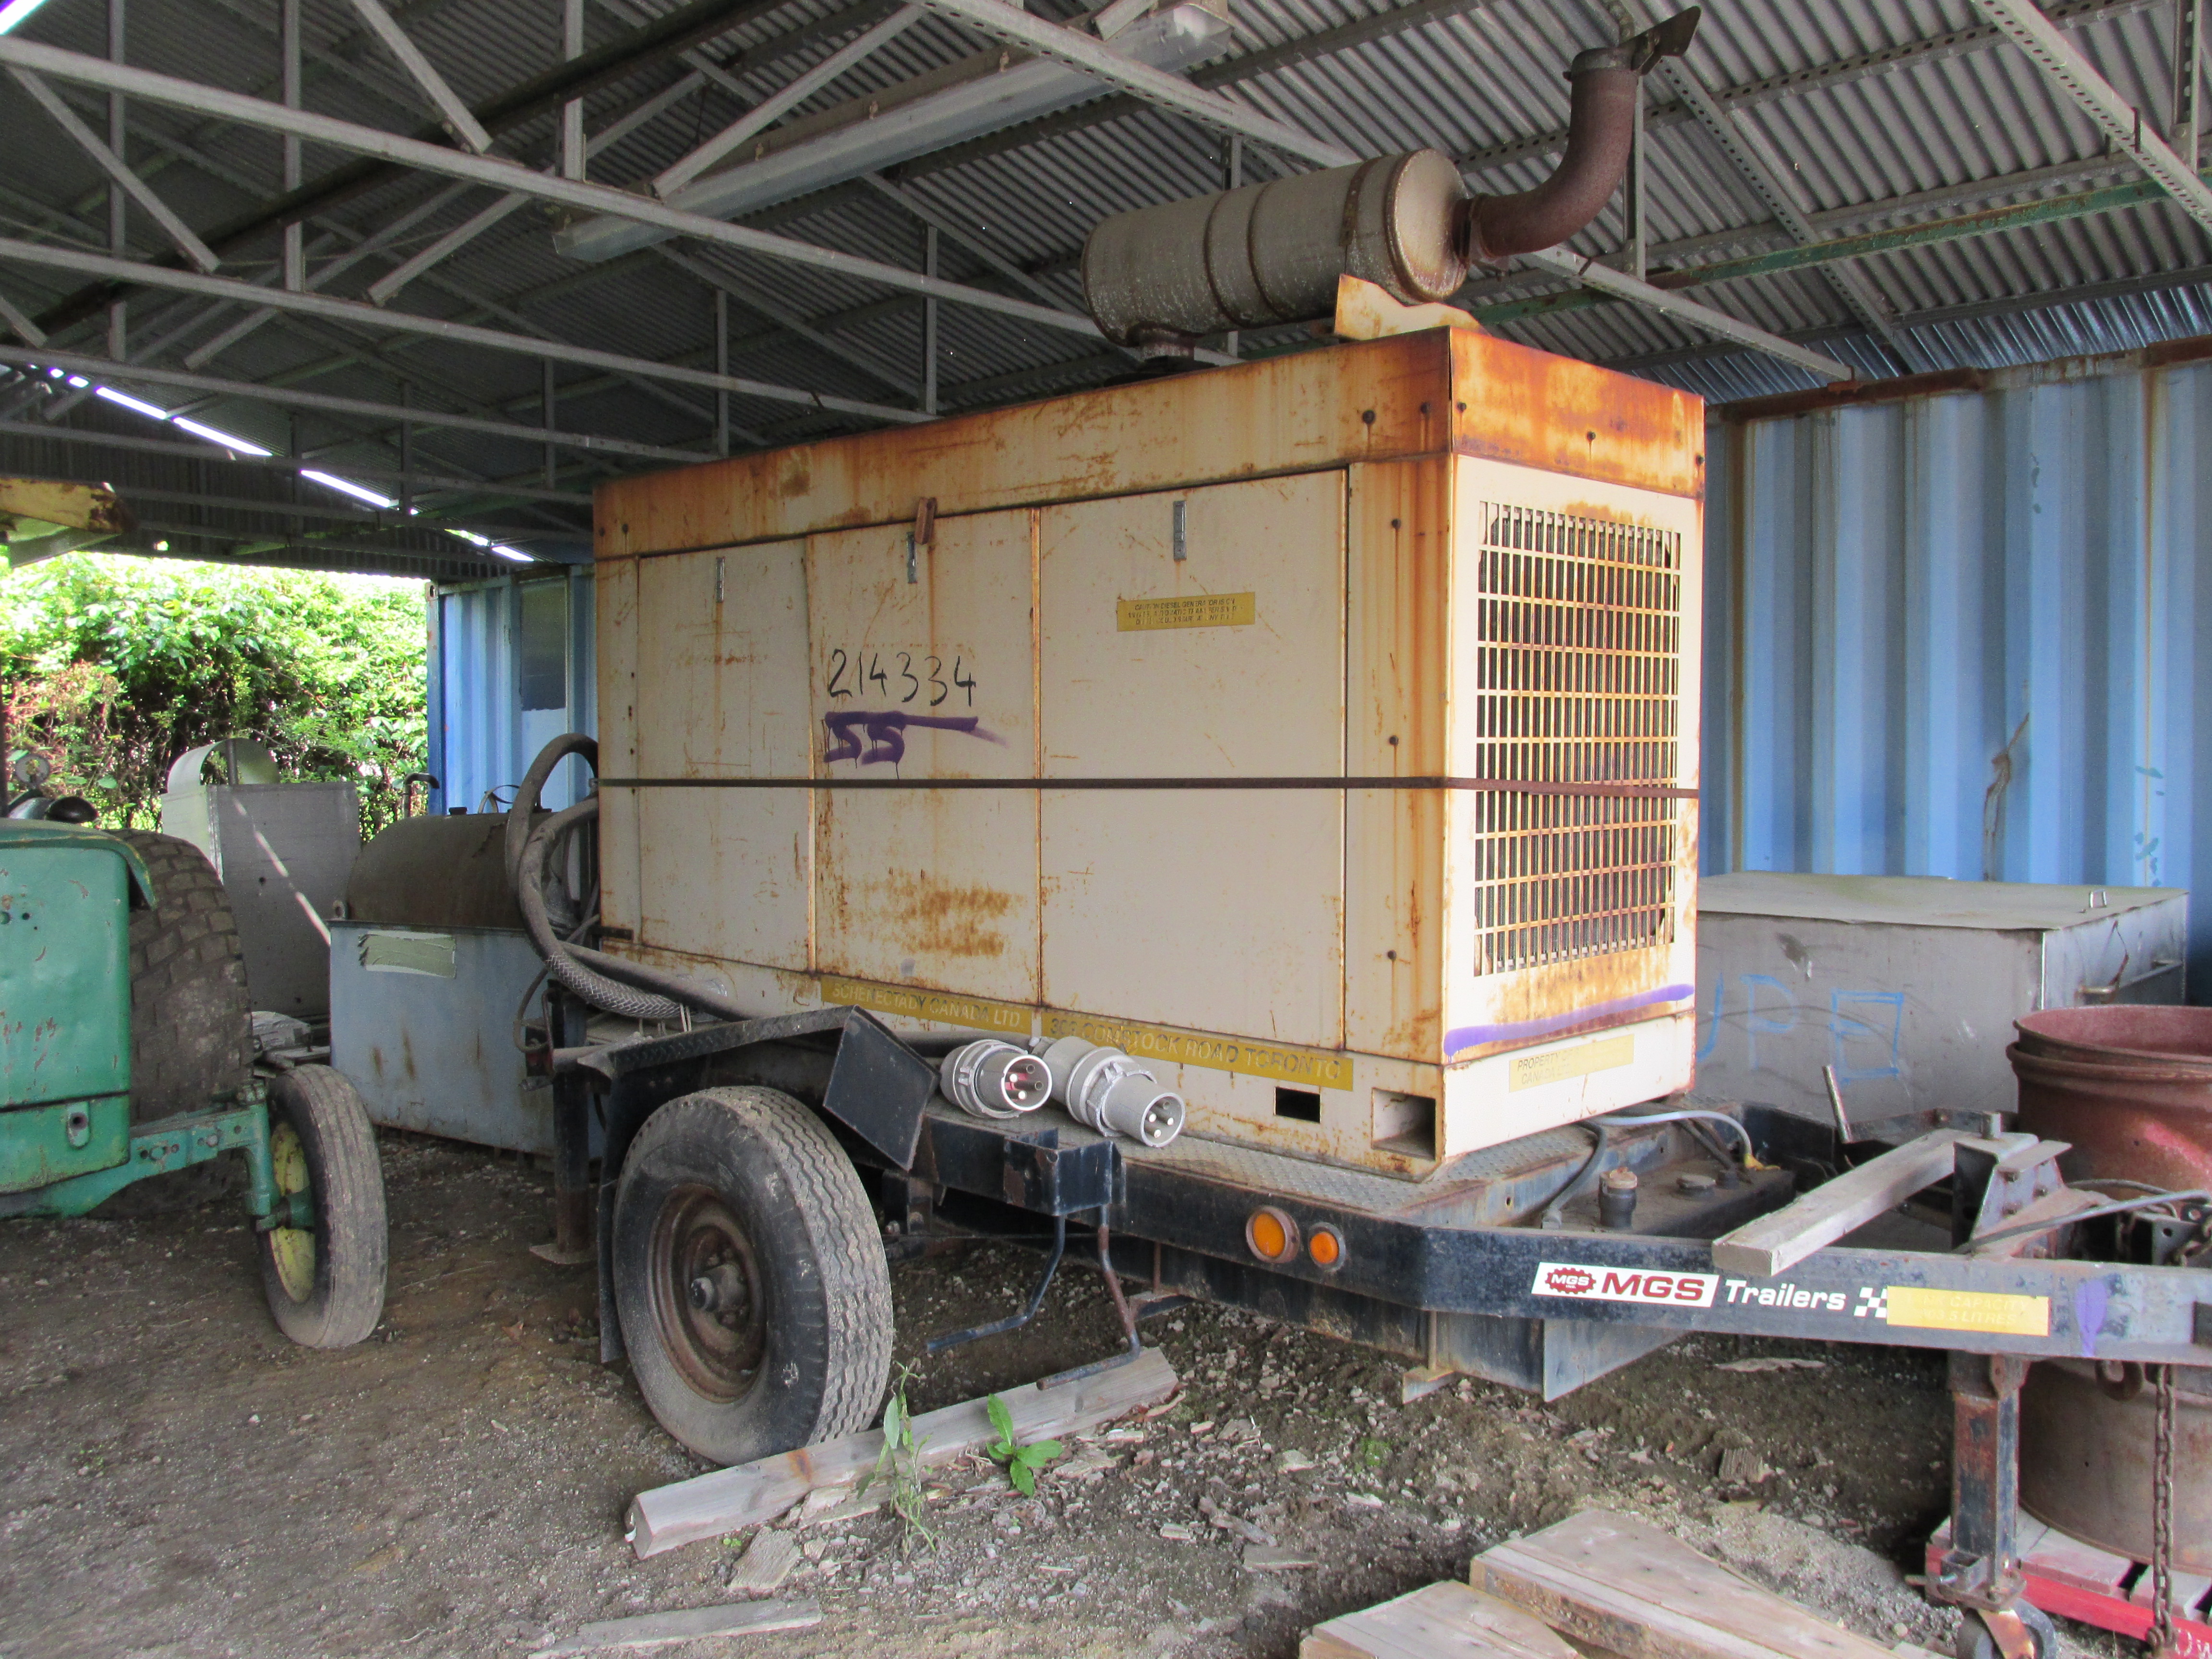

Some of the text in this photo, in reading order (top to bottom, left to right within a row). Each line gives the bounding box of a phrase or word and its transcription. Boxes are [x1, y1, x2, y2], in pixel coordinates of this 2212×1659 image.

[828, 648, 977, 707] 214334
[831, 982, 927, 1012] SCHENECTADY
[929, 998, 989, 1022] CANADA
[1082, 1022, 1181, 1054] COMSTOCK
[1185, 1039, 1239, 1063] ROAD
[1246, 1047, 1342, 1080] TORONTO
[1517, 1052, 1559, 1071] PROPERTY
[1551, 1274, 1590, 1286] MGS
[1601, 1272, 1847, 1311] MGS Trailers
[1950, 1295, 2030, 1312] CAPACITY
[1961, 1310, 2017, 1325] LITRES
